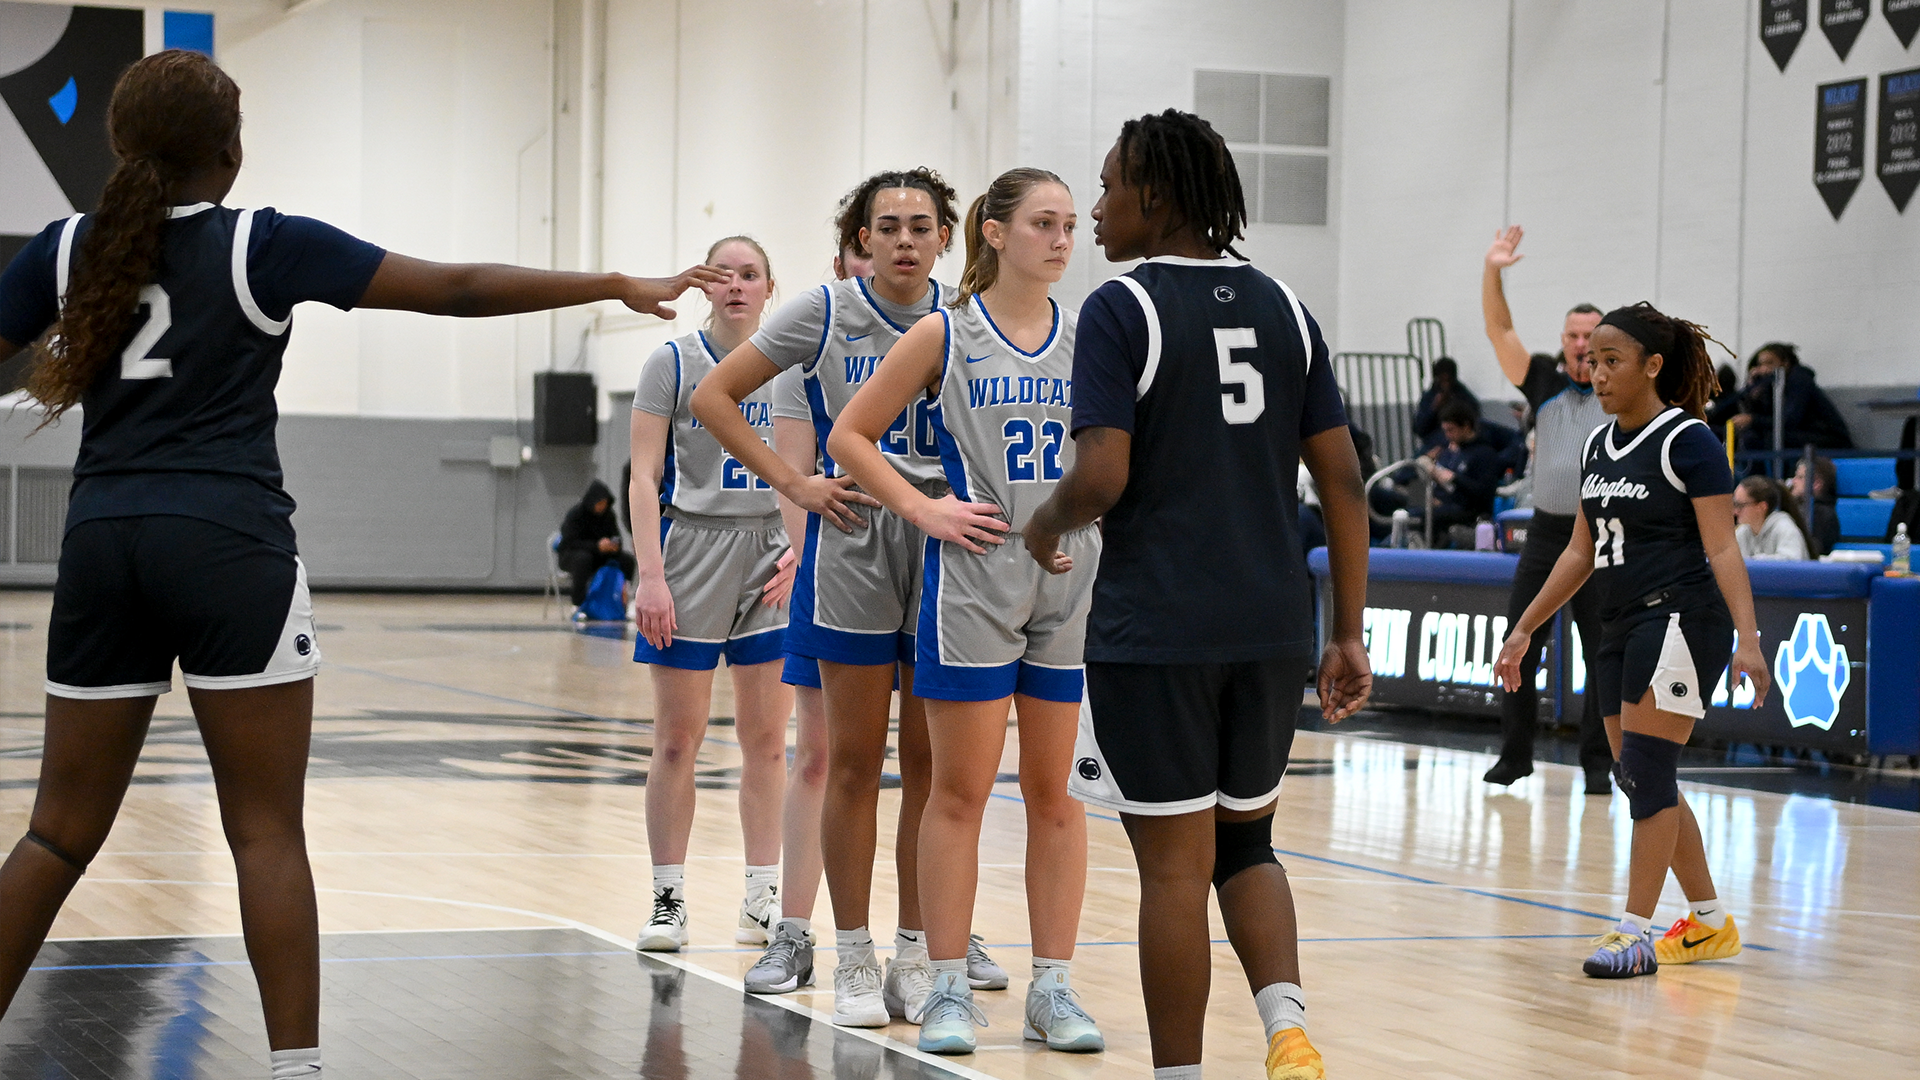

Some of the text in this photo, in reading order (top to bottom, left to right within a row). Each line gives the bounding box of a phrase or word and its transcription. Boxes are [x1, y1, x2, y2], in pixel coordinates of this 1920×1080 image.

[120, 284, 173, 379] 2
[1213, 327, 1266, 425] 5
[1001, 417, 1067, 484] 22
[1594, 517, 1625, 569] 21
